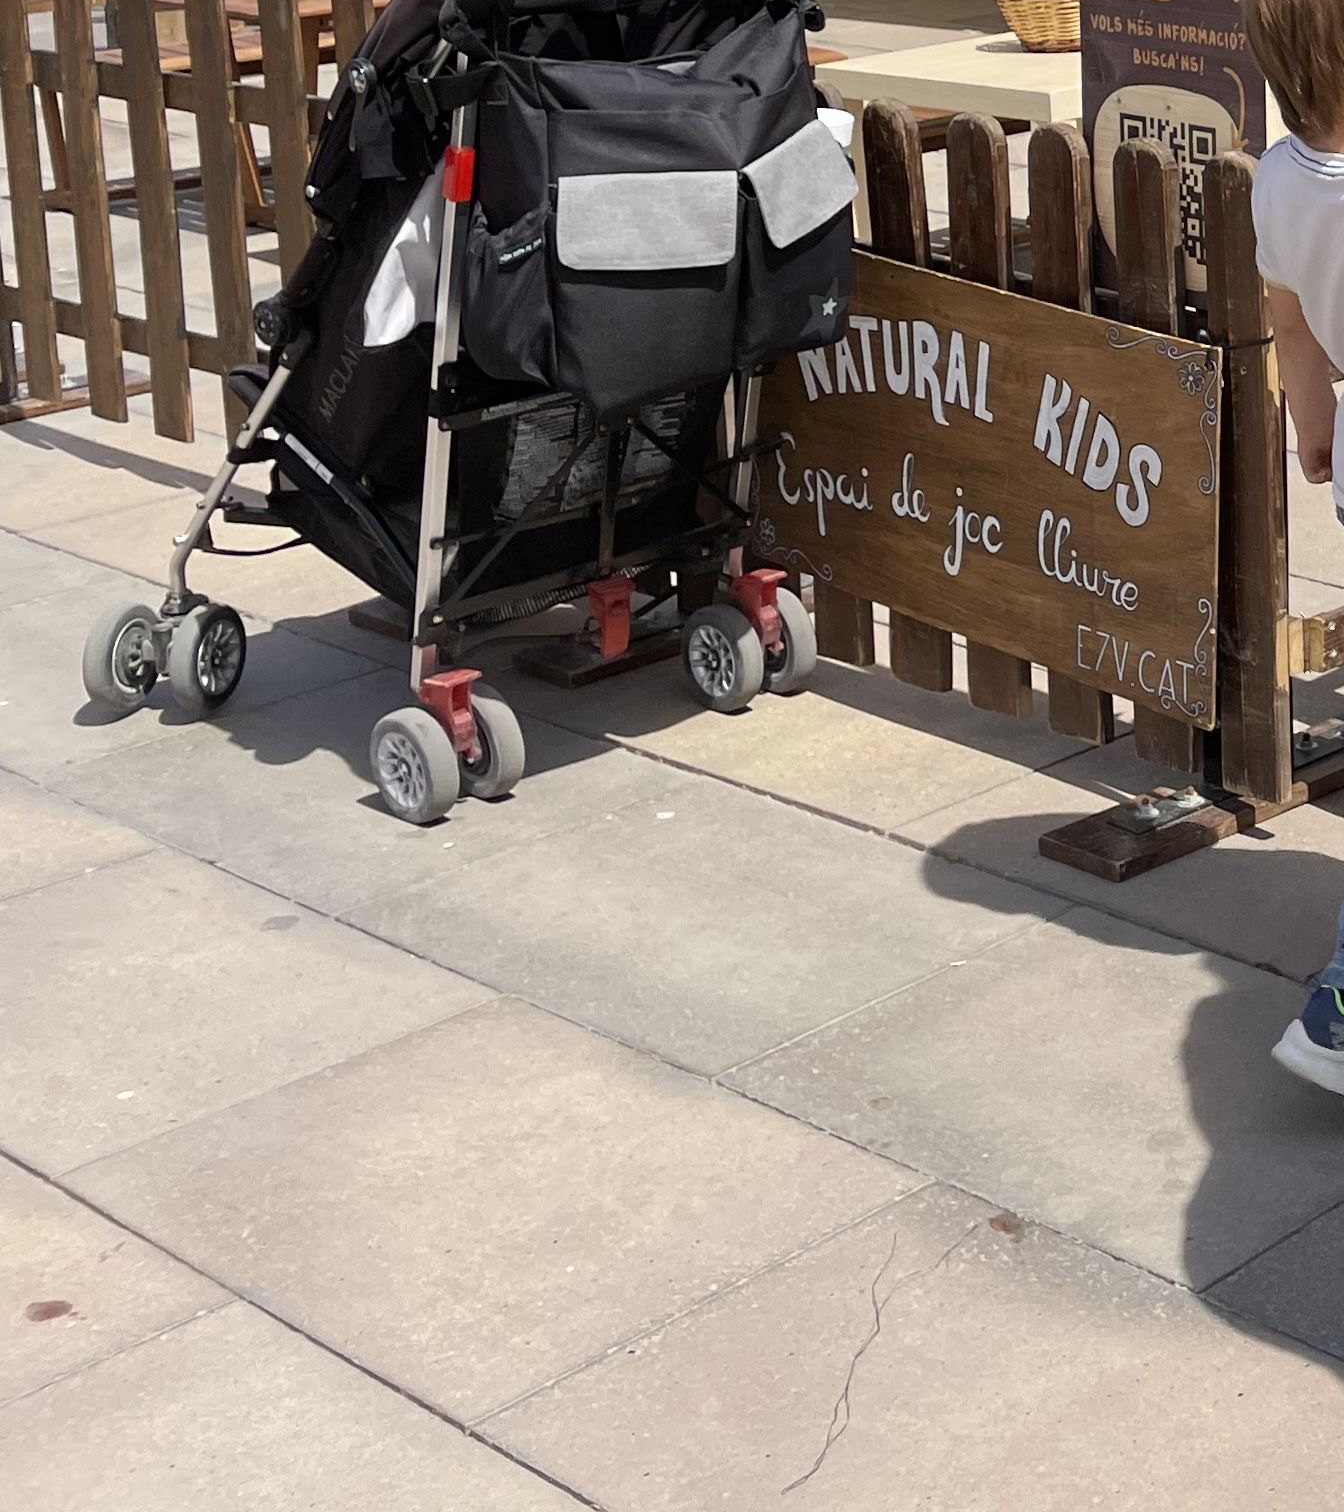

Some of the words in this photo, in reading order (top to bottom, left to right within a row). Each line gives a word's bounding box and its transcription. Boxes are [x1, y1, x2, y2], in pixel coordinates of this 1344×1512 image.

[1090, 11, 1123, 34] VOLS
[1127, 9, 1154, 37] MÉS
[1158, 22, 1248, 51] INFORMACIÓ?
[1132, 46, 1206, 77] BUSCA'NS!
[796, 314, 995, 427] NATURAL
[1032, 372, 1164, 528] KIDS
[775, 430, 874, 537] Espai
[891, 452, 931, 524] de
[943, 486, 1004, 577] joc
[1037, 508, 1141, 612] lliure
[1075, 623, 1196, 706] E7V.CAT
